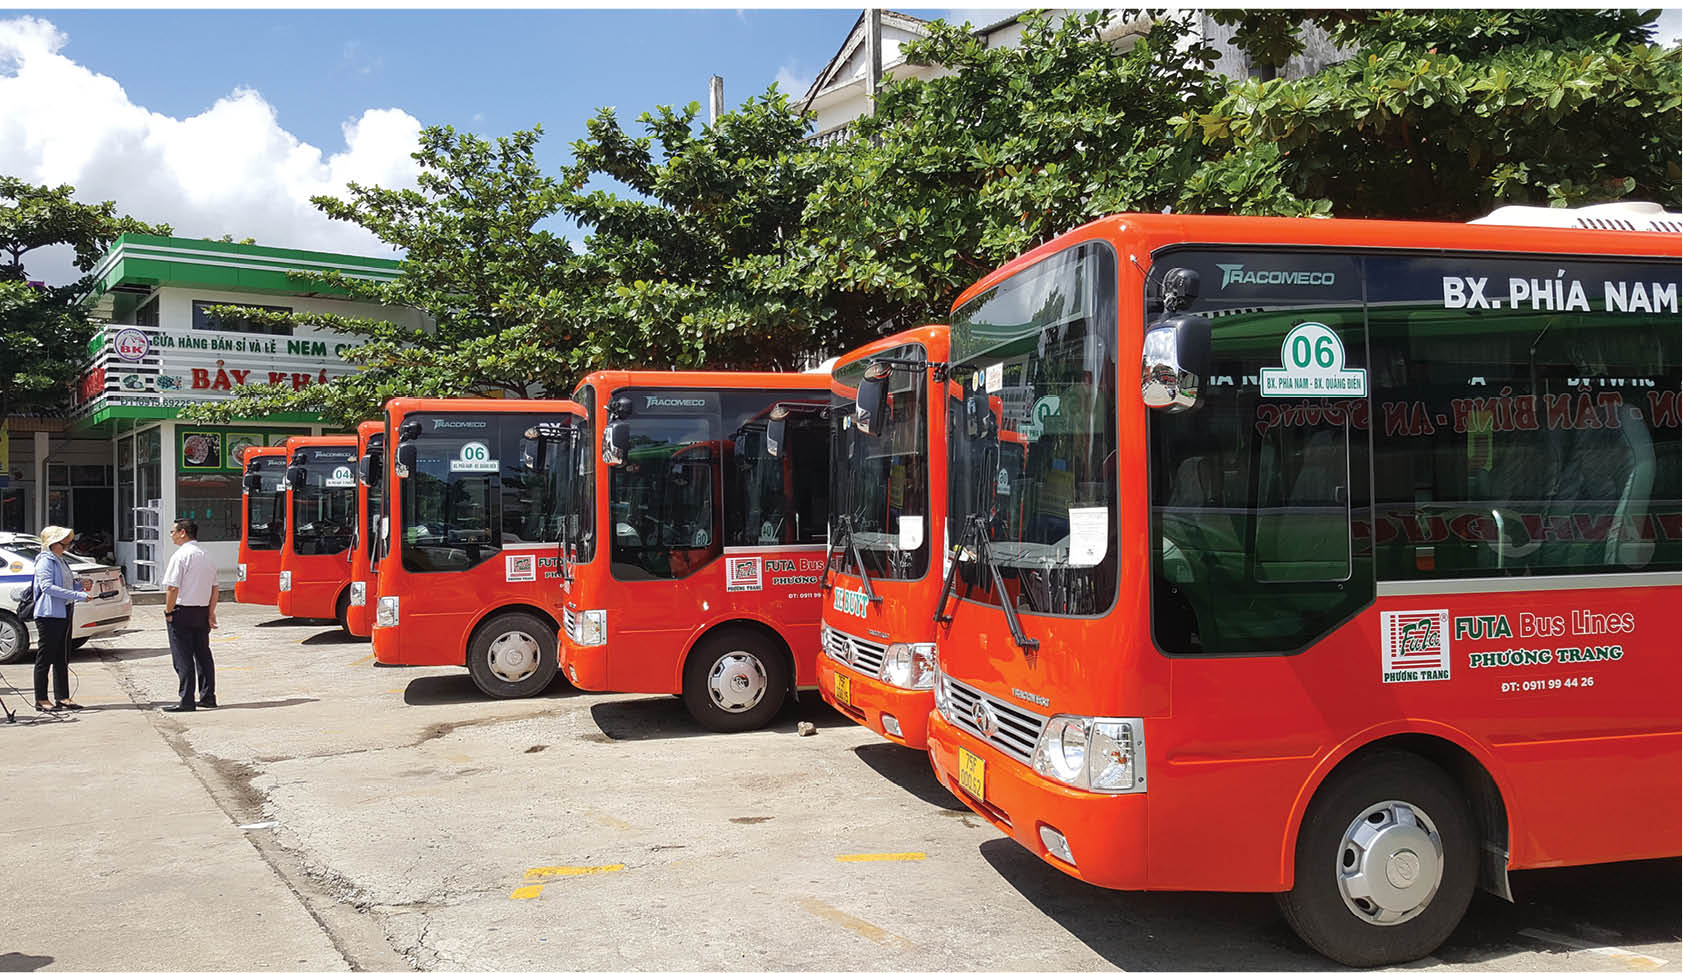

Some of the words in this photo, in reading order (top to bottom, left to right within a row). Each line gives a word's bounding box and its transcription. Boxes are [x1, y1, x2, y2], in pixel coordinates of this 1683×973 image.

[1216, 263, 1335, 290] TRACOMECO
[1442, 276, 1501, 309] BX.
[1508, 269, 1591, 312] PHÍA
[1603, 280, 1679, 313] NAM
[120, 346, 143, 354] BK
[152, 332, 175, 348] CỬA
[178, 334, 208, 350] HÀNG
[211, 335, 233, 351] BÁN
[249, 340, 262, 353] VÀ
[287, 340, 327, 356] NEM
[1292, 335, 1335, 368] 06
[191, 359, 251, 390] BẢY
[1266, 377, 1277, 389] BX.
[1294, 377, 1309, 389] NAM
[1314, 377, 1325, 389] BX.
[1325, 374, 1346, 390] QUẢNG
[645, 395, 705, 408] TRACOMECO
[432, 418, 487, 429] TRACOMECO
[465, 447, 485, 460] 06
[335, 469, 350, 479] 04
[765, 559, 796, 572] FUTA
[799, 558, 825, 571] Bus
[772, 576, 817, 585] PHƯƠNG
[833, 586, 844, 612] XE
[844, 586, 869, 618] BUÝT
[1454, 615, 1513, 640] FUTA
[1519, 611, 1565, 638] Bus
[1571, 609, 1635, 636] Lines
[1468, 648, 1553, 668] PHƯƠNG
[1556, 645, 1624, 662] TRANG
[1384, 670, 1418, 682] PHƯƠNG
[1420, 669, 1449, 680] TRANG
[1501, 682, 1520, 693] ĐT:
[1522, 680, 1546, 691] 0911
[1548, 679, 1562, 689] 99
[1563, 678, 1578, 688] 44
[1581, 677, 1594, 687] 26
